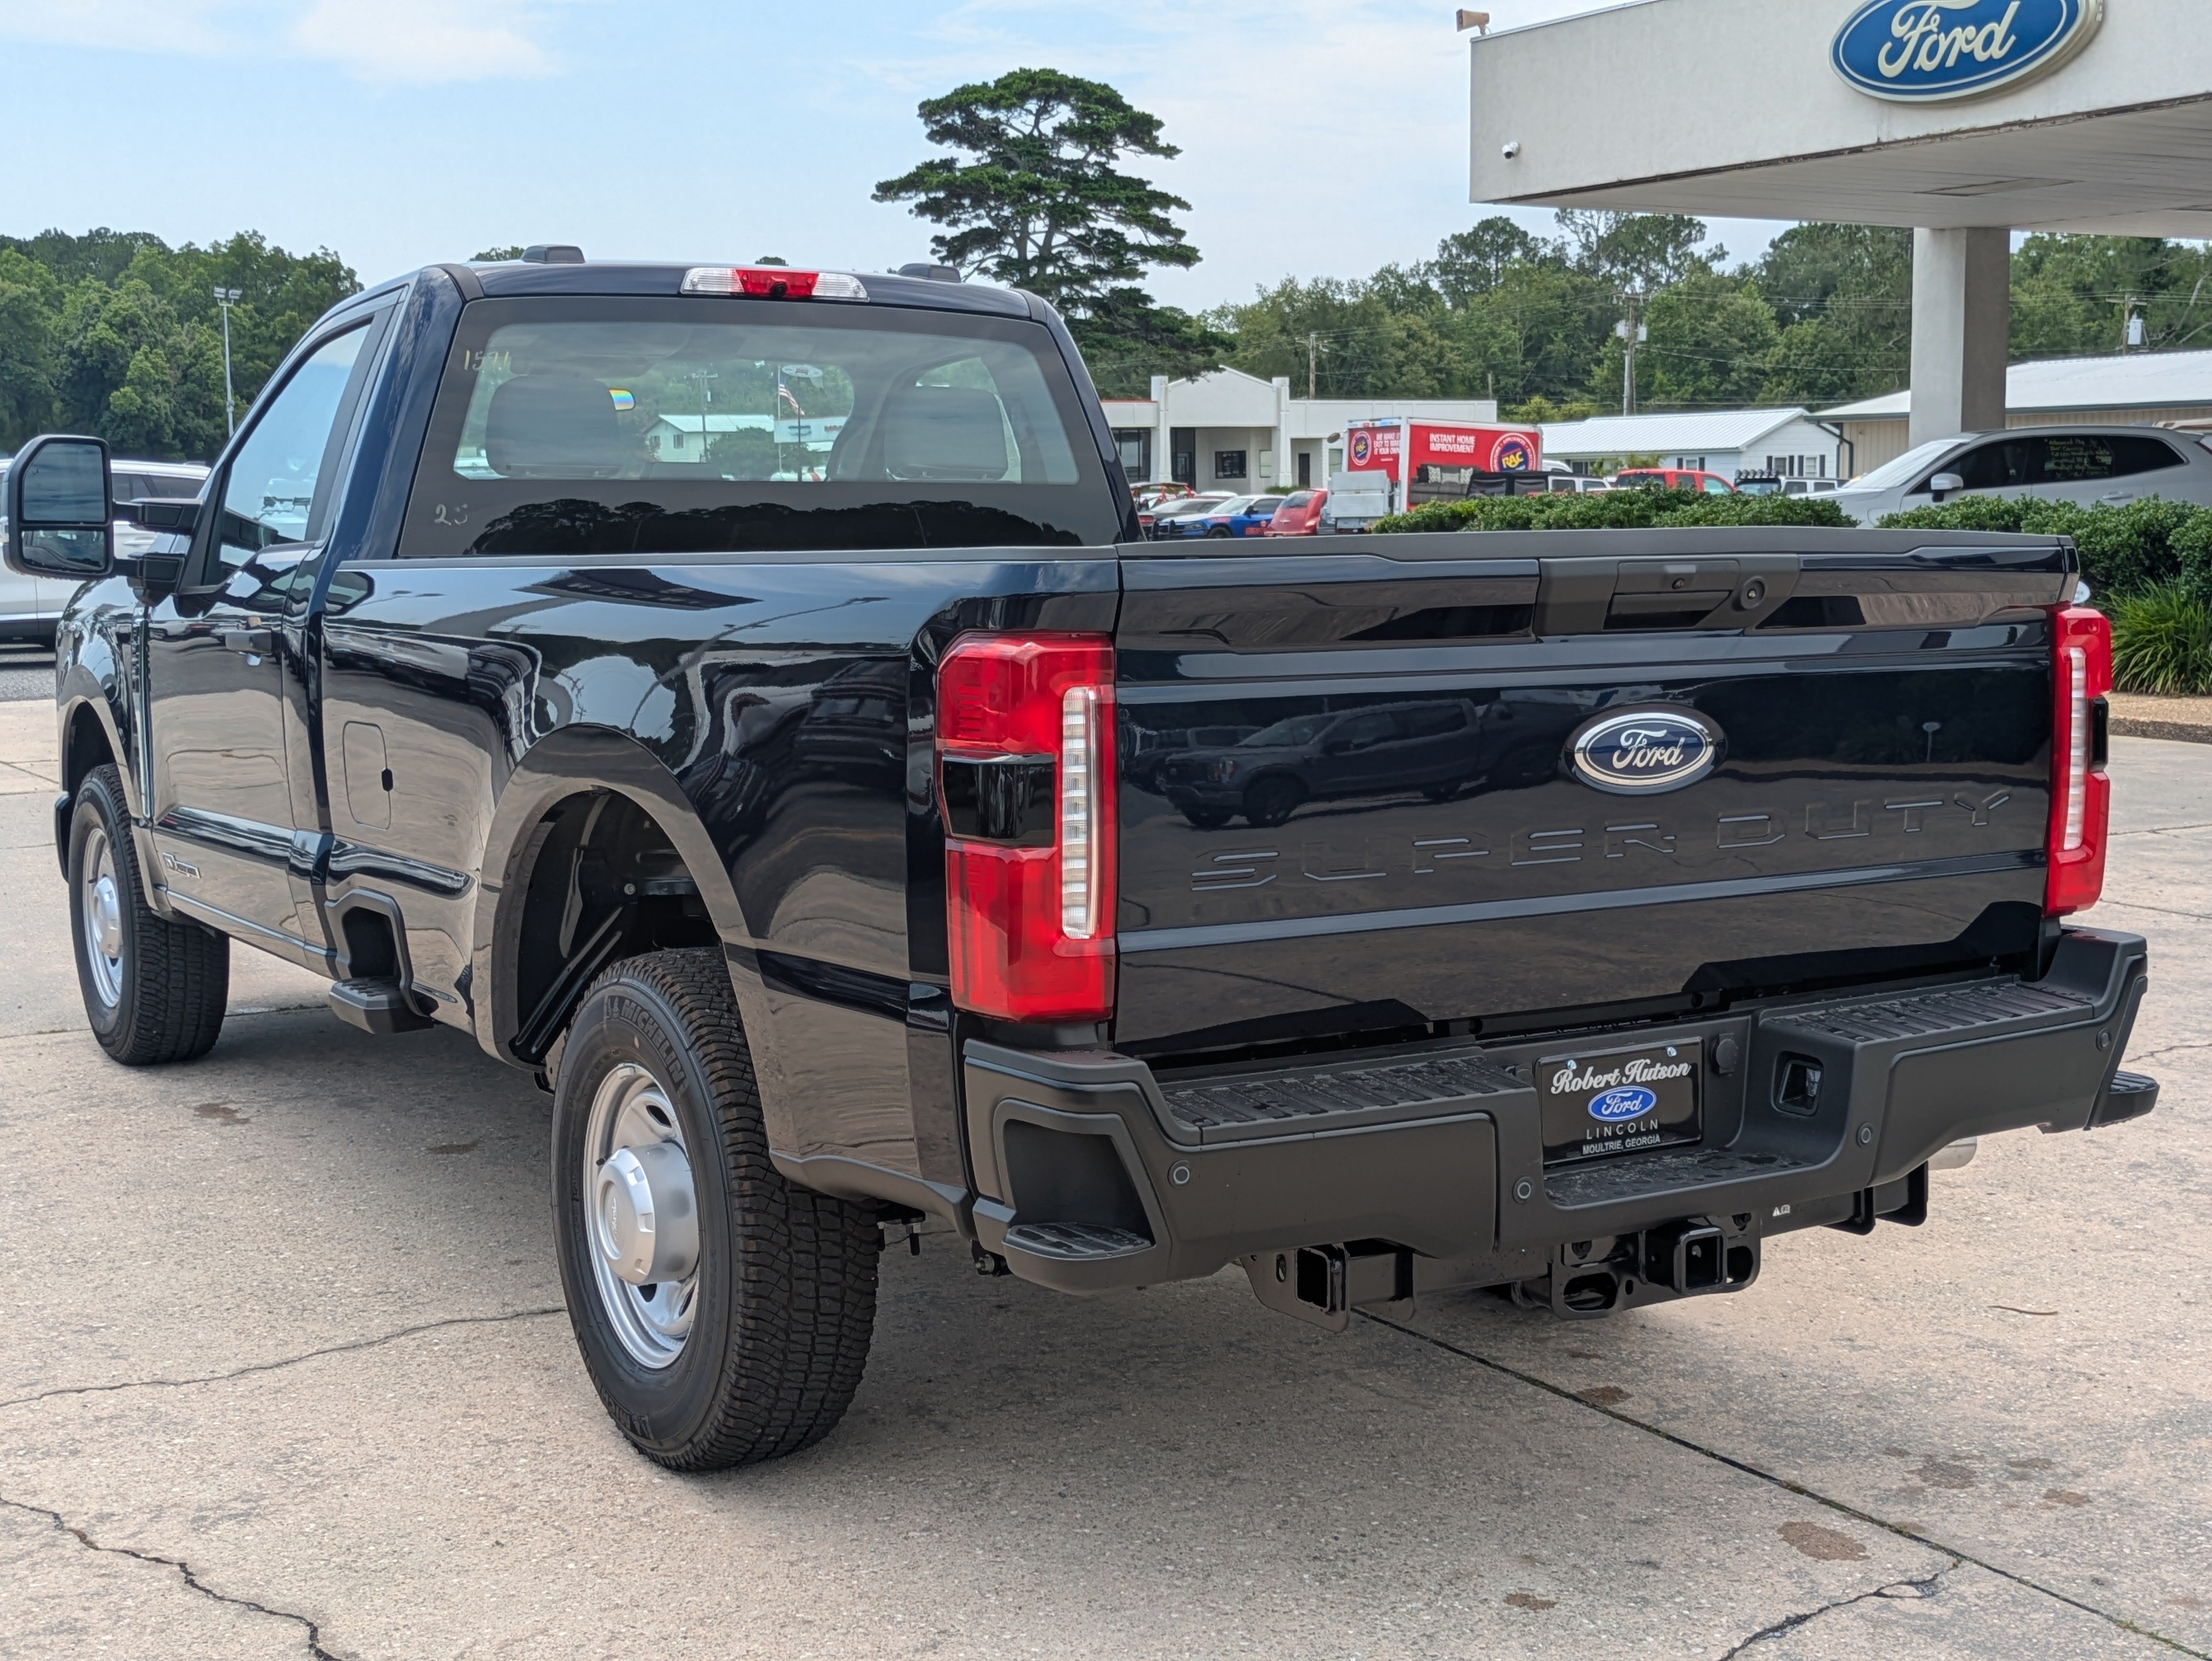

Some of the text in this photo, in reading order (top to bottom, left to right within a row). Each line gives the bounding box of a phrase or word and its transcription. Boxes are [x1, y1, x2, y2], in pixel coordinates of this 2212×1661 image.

[1878, 0, 2021, 78] Ford
[1429, 432, 1475, 445] INSTANT HOME
[1429, 442, 1475, 454] IMPROVEMENT
[1501, 451, 1524, 469] RAC
[1612, 729, 1685, 769] Ford
[1191, 788, 2010, 891] SUPER DUTY
[621, 998, 687, 1083] MICHELIN
[1550, 1058, 1692, 1095] Robert Hutson
[1601, 1091, 1644, 1116] Ford
[1586, 1118, 1659, 1140] LINCOLN
[1582, 1133, 1661, 1155] MOULTRIE, GEORGIA
